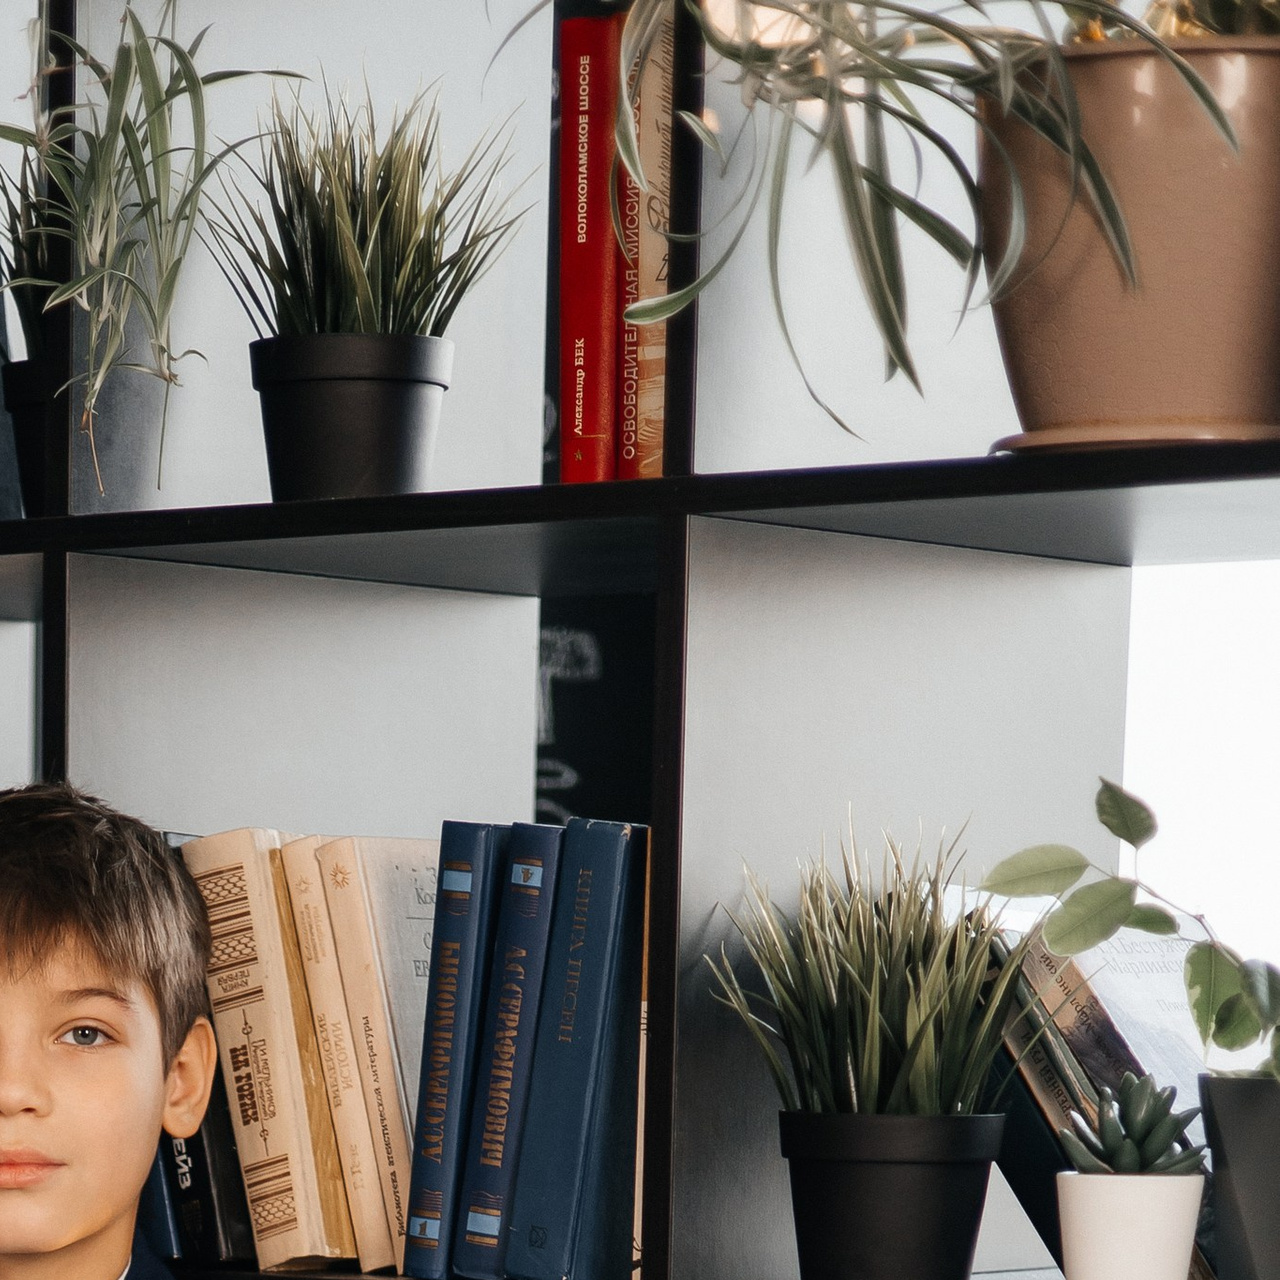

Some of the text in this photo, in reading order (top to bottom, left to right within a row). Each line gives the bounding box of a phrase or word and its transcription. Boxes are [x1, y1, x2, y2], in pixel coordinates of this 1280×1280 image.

[577, 55, 590, 242] ВОЛОКОЛАМСКОЕ ШОССЕ
[573, 338, 585, 435] Александр БЕК
[622, 268, 638, 459] ОСВОБОДИТЕЛНАЯ
[569, 867, 593, 952] КНИГА
[228, 1044, 260, 1125] НА ГОРАХ
[329, 1020, 352, 1090] ИСТОРИИ
[361, 1014, 408, 1237] Библиотека атеистической литературы
